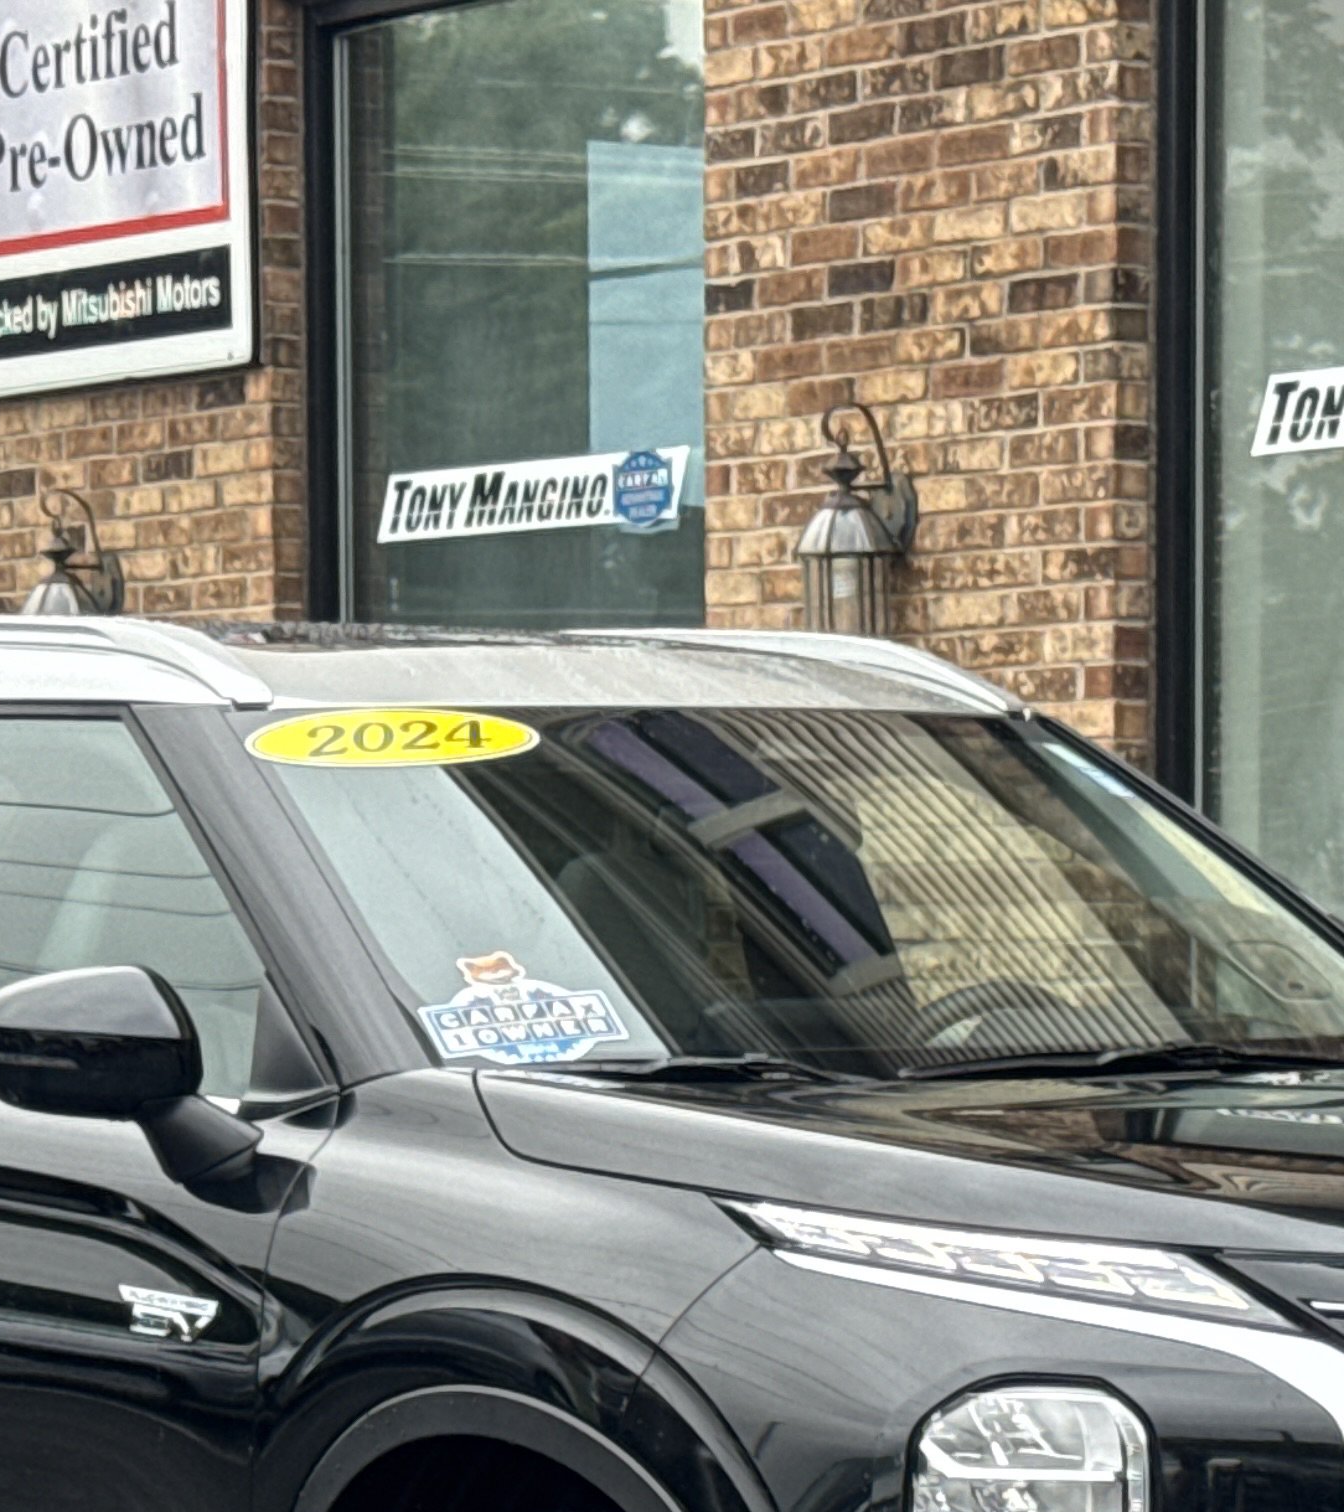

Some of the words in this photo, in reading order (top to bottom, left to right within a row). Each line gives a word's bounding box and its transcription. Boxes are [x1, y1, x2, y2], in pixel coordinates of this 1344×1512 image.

[36, 294, 57, 340] by
[61, 276, 153, 327] Mitsubishi
[156, 273, 221, 314] Motors
[306, 720, 492, 758] 2024
[439, 1000, 599, 1029] CARFAX
